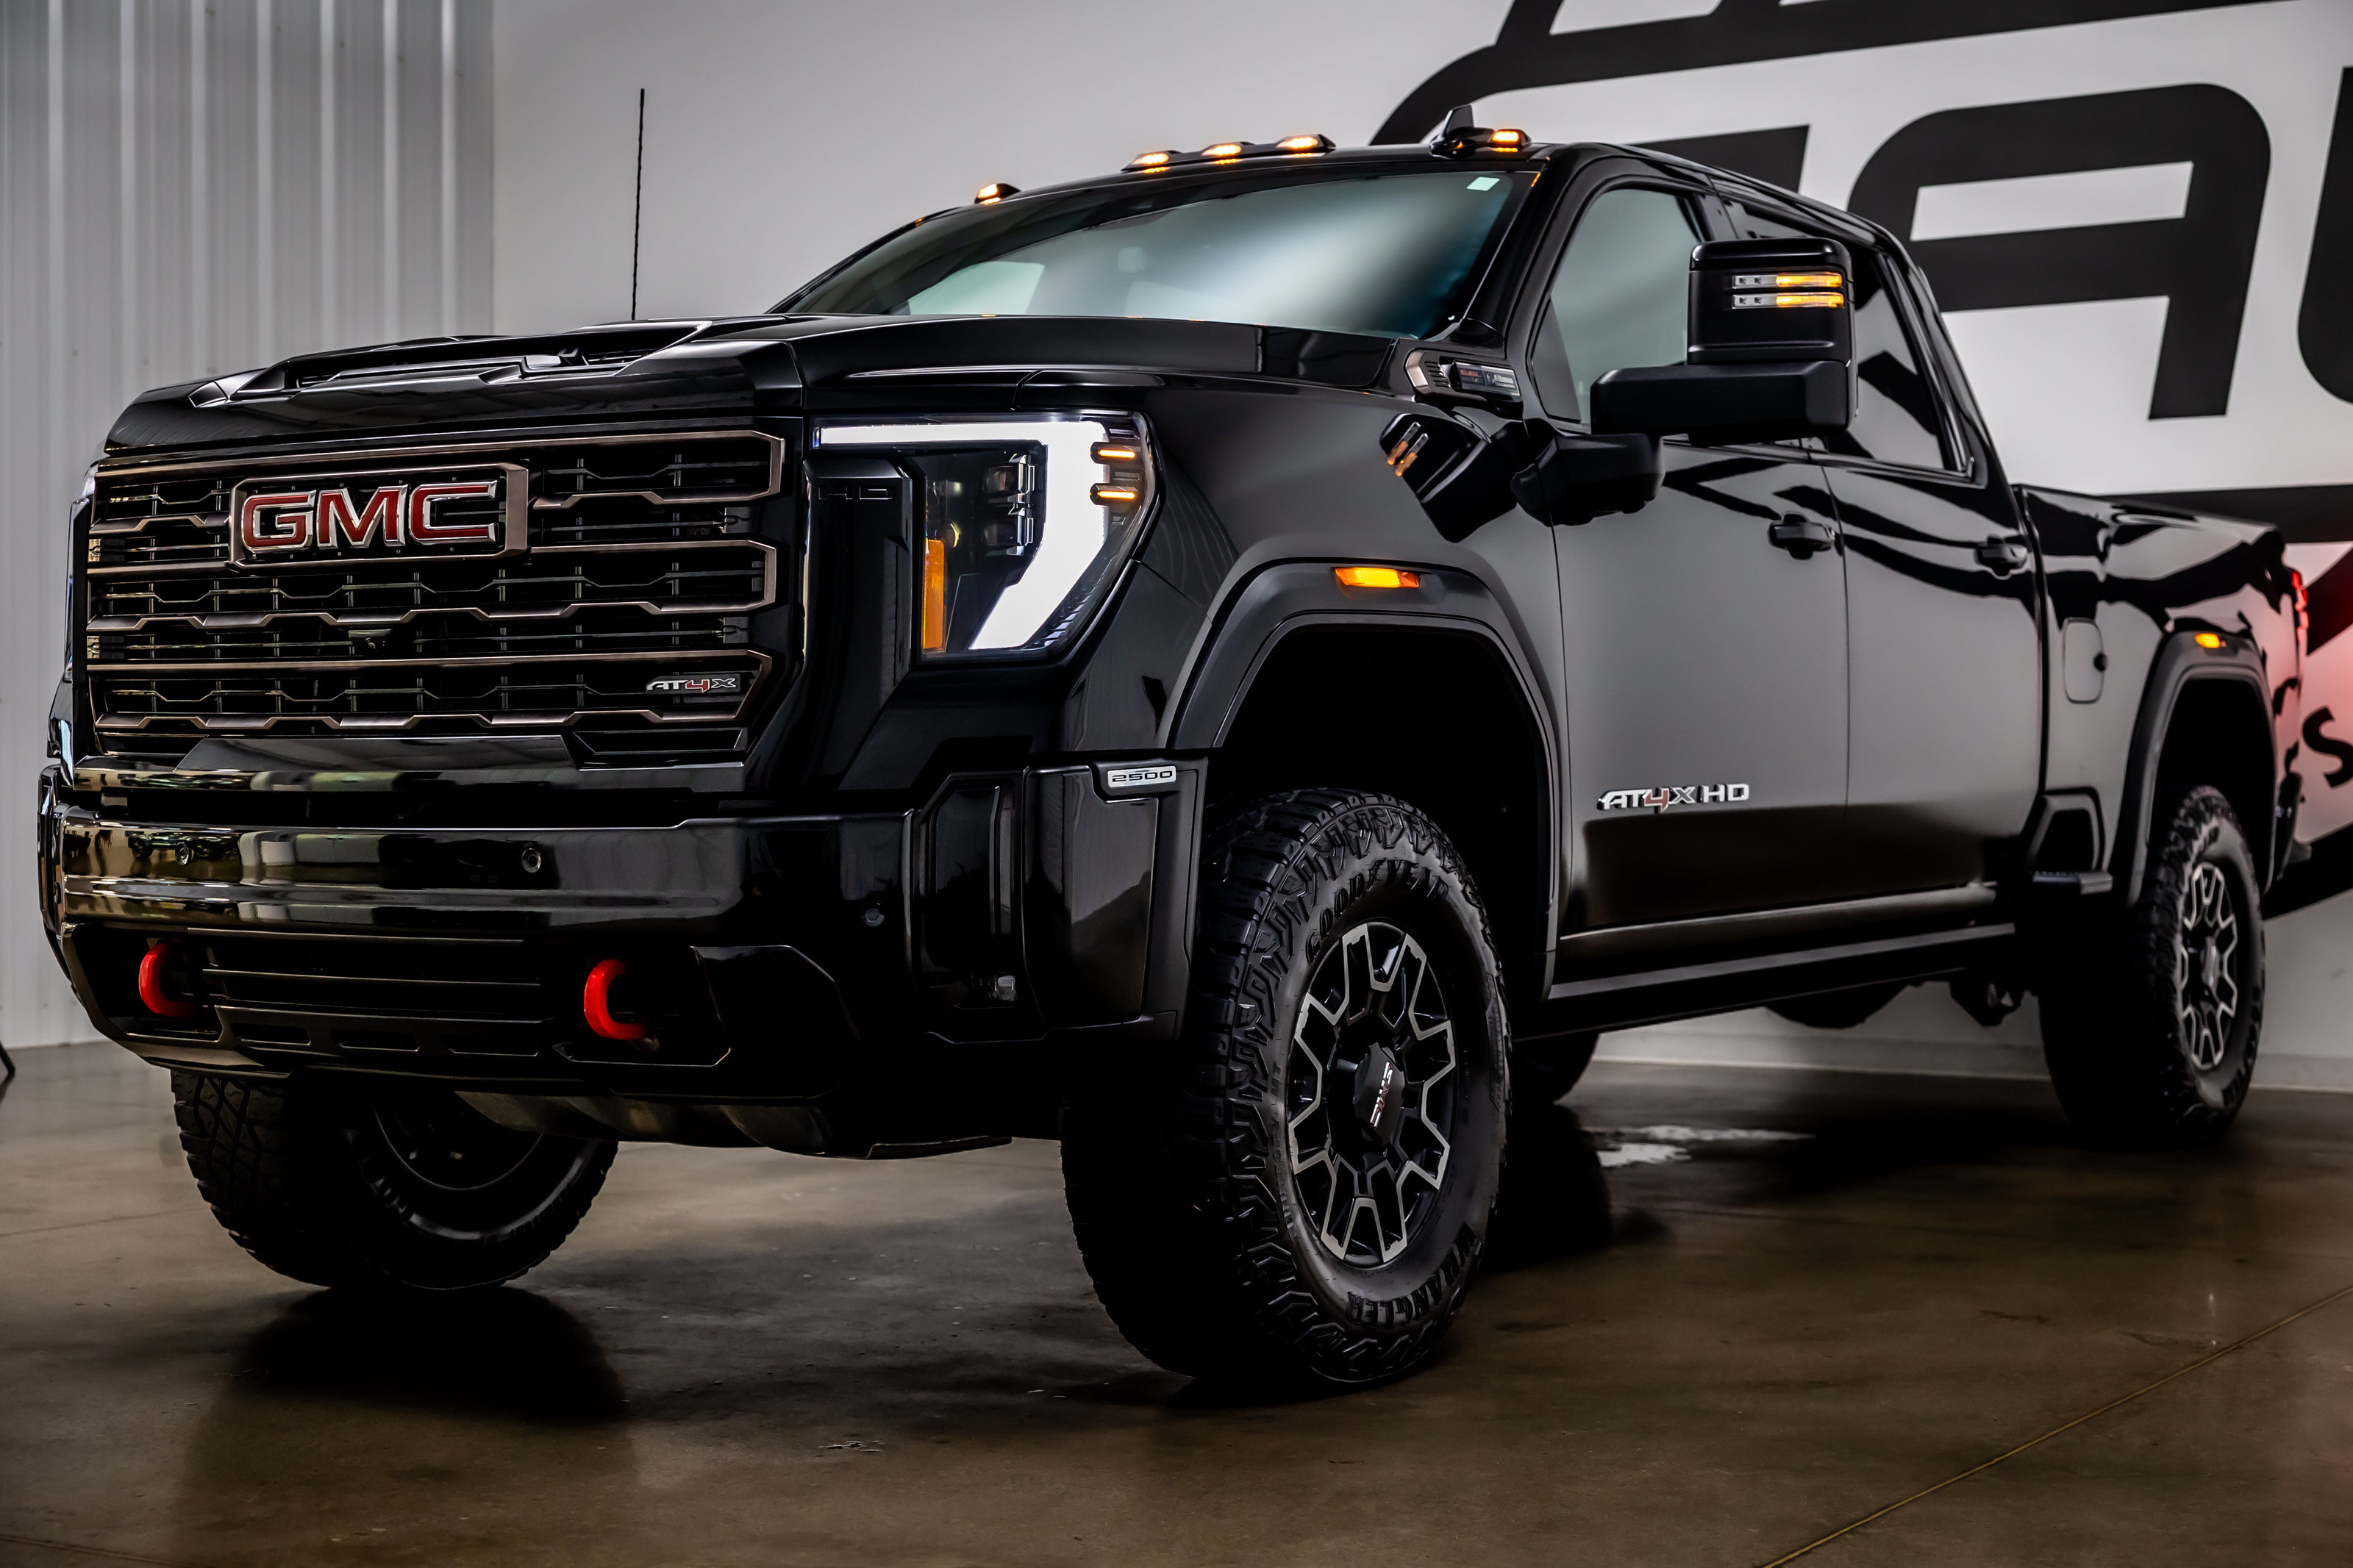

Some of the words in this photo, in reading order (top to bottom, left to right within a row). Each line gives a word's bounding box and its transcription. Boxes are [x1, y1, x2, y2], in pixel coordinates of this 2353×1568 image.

[242, 479, 499, 554] GMC
[818, 485, 894, 501] HD
[646, 678, 737, 693] AT4X
[1112, 770, 1173, 783] 2500
[1597, 786, 1696, 814] AT4X
[1698, 783, 1750, 803] HD
[1305, 858, 1449, 966] GOODYEAR
[1369, 1061, 1393, 1128] GMC
[1346, 1222, 1477, 1330] WRANGLER
